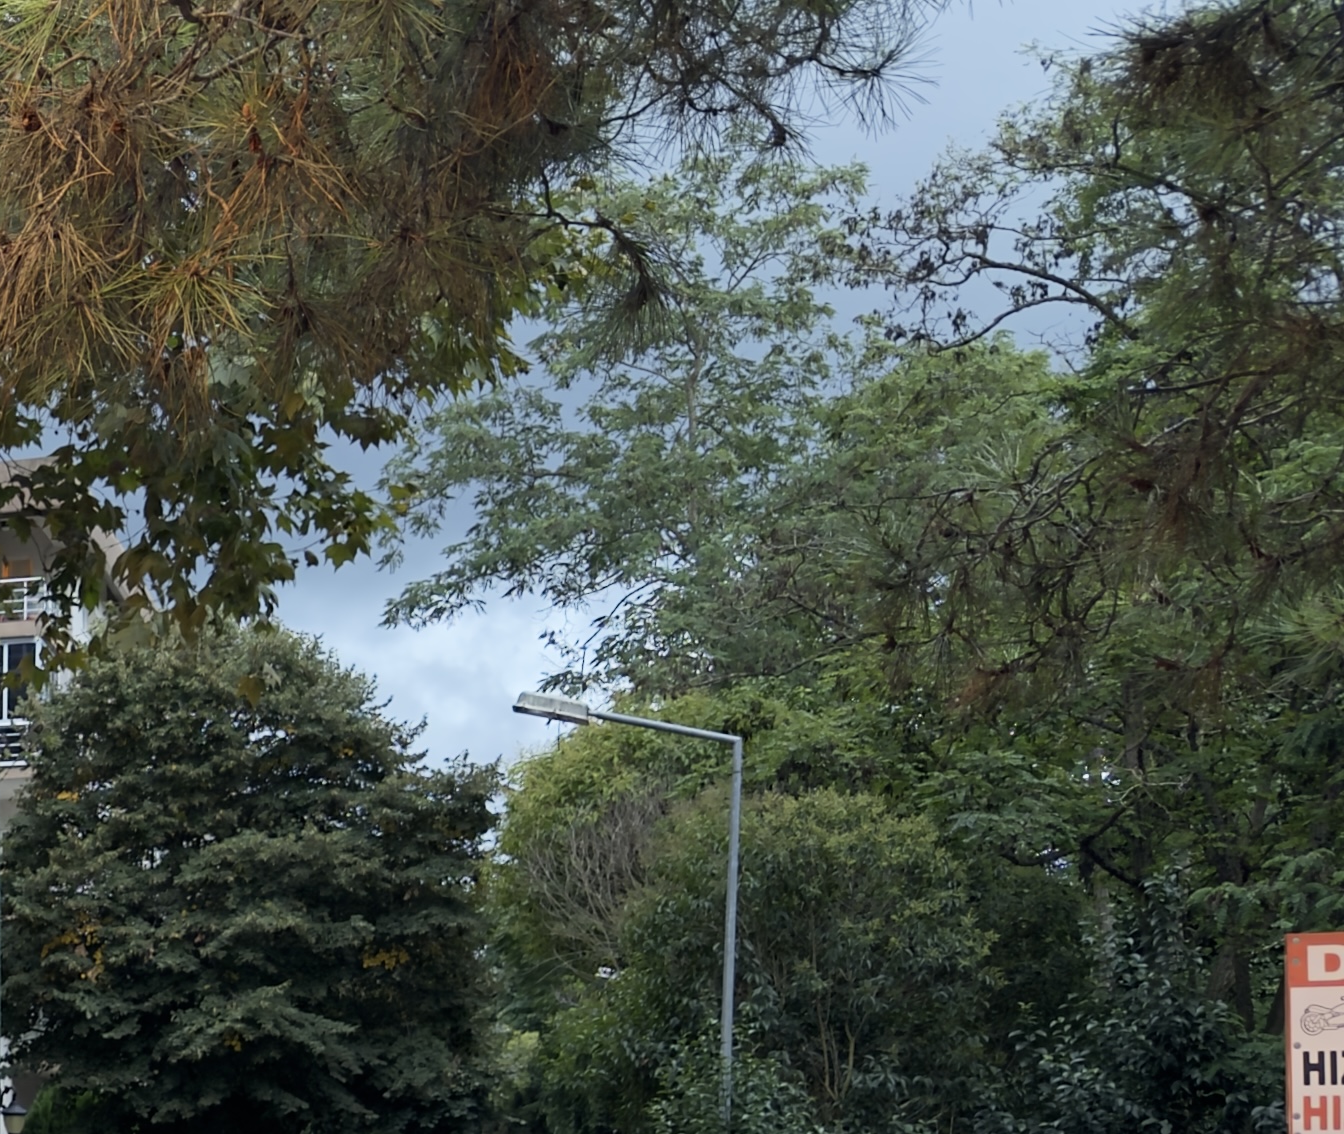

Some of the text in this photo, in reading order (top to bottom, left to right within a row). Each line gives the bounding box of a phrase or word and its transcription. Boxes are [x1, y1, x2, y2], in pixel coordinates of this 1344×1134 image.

[1307, 945, 1344, 982] D
[1303, 1051, 1344, 1086] HI
[1303, 1096, 1342, 1131] HI
